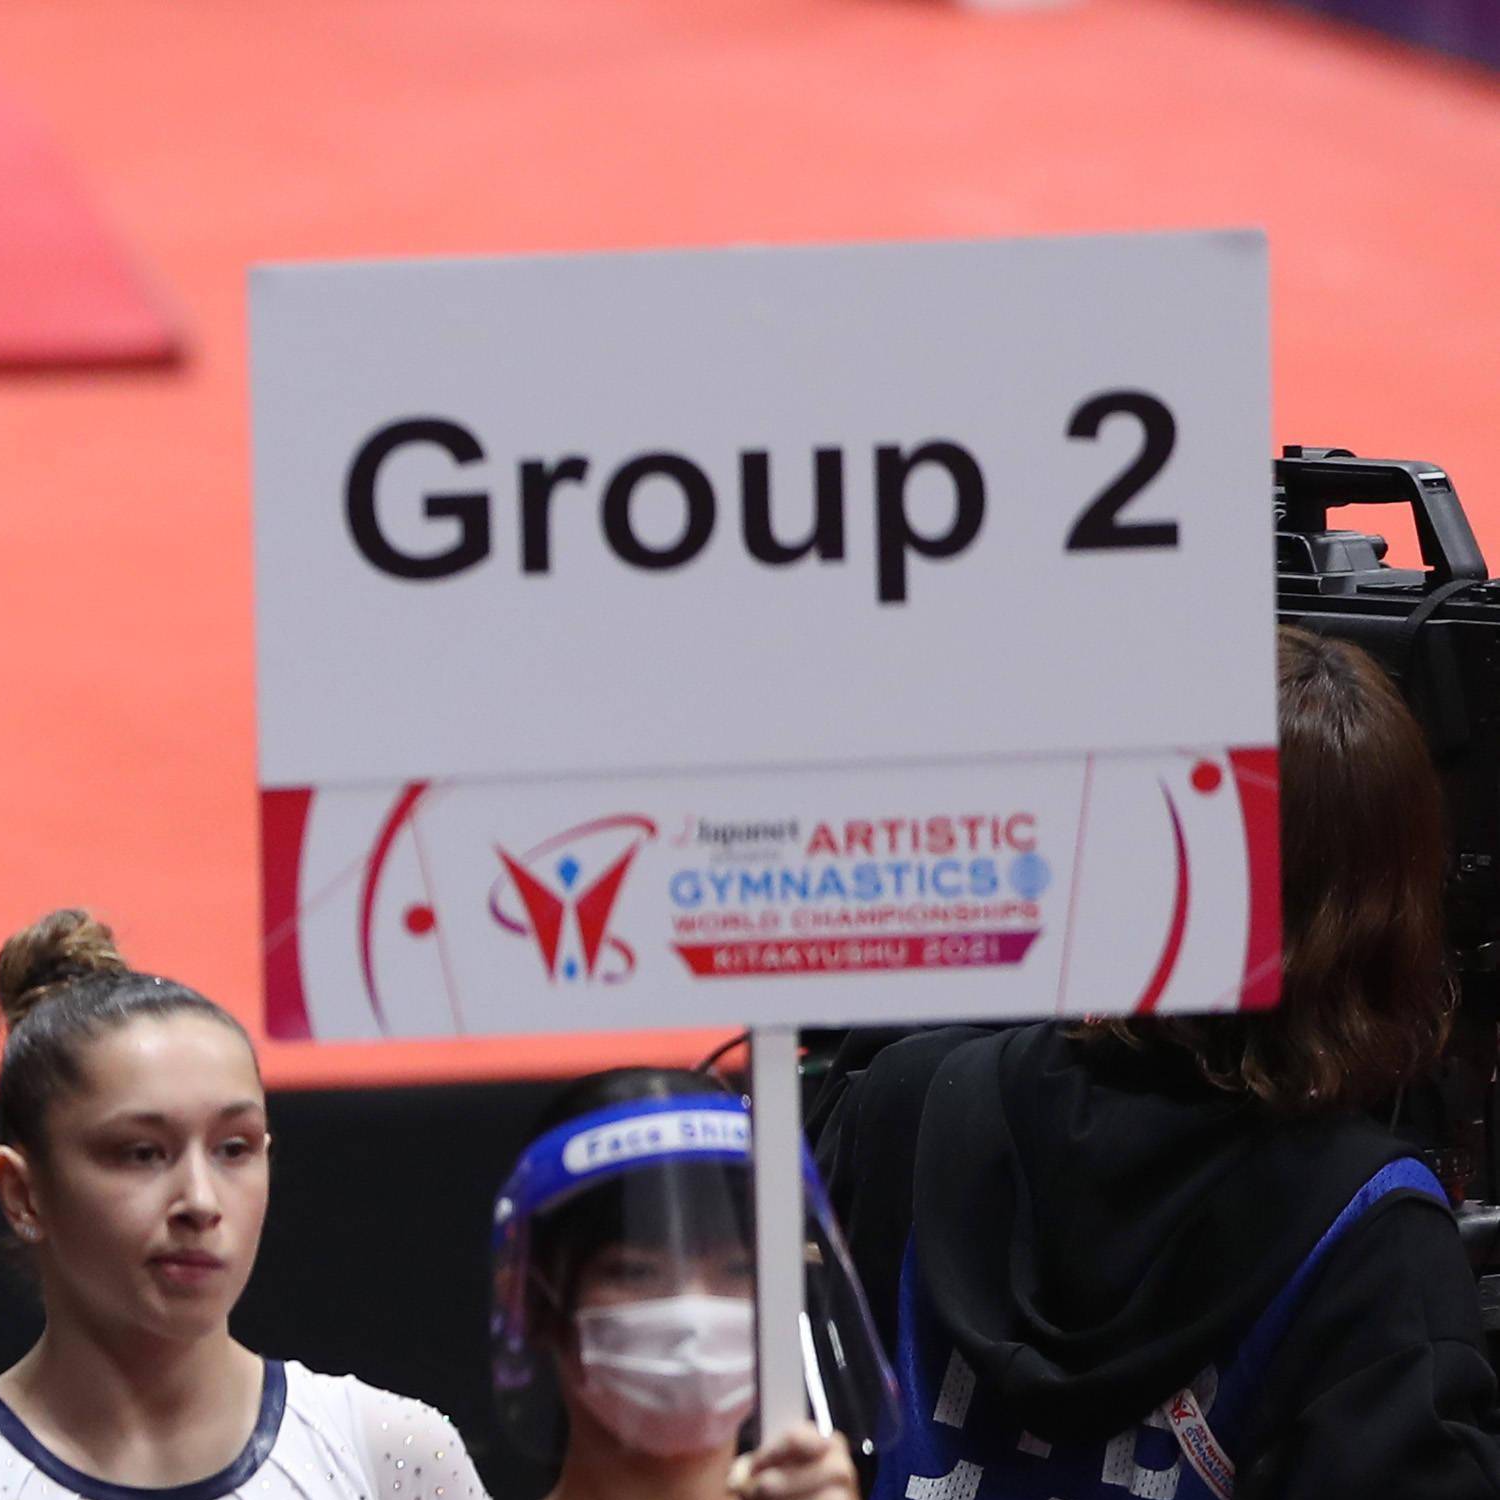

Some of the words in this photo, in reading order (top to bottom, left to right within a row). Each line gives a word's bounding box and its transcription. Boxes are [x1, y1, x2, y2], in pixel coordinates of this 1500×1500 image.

[344, 415, 988, 606] Group
[1064, 389, 1181, 555] 2
[806, 812, 1036, 857] ARTISTIC
[669, 857, 999, 909] GYMNASTICS
[673, 910, 780, 934] WORLD
